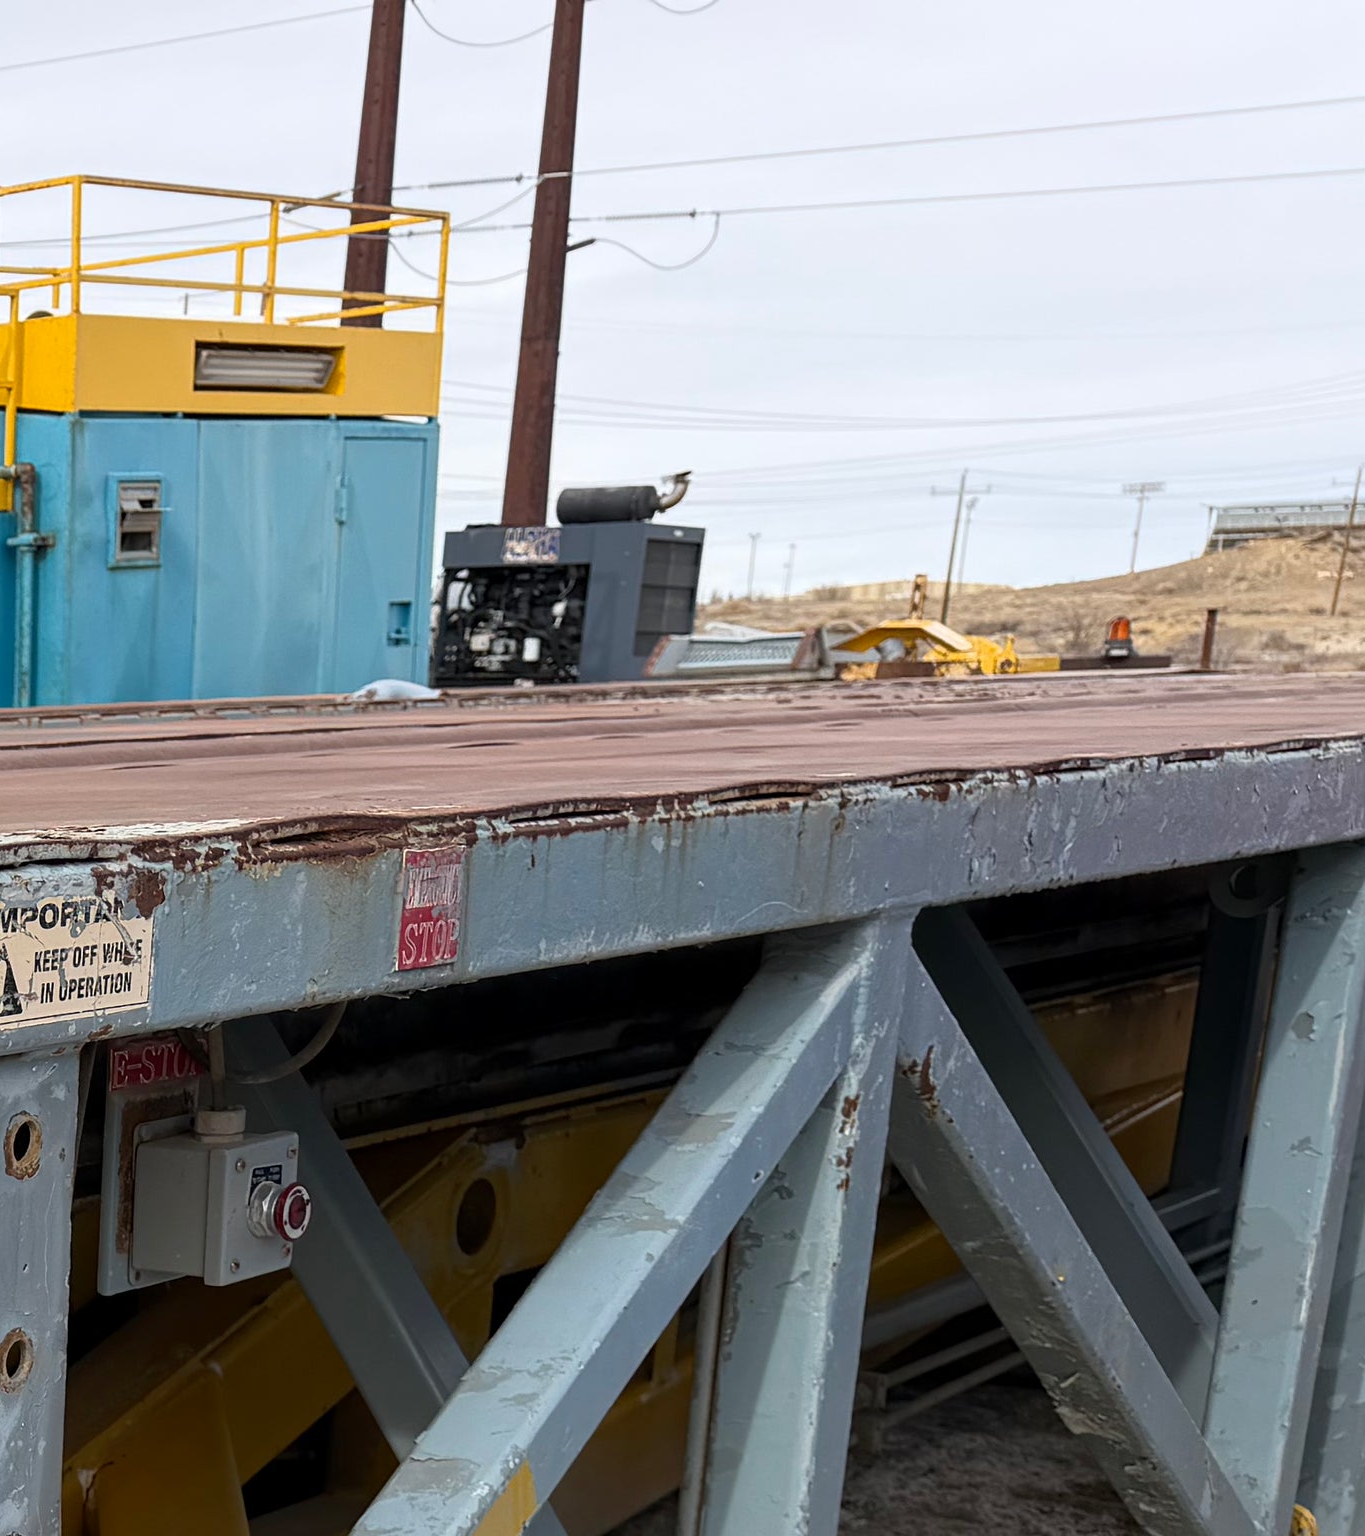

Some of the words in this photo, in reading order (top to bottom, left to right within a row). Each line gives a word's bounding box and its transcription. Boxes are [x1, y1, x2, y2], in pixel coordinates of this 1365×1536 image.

[34, 948, 68, 973] KEEP
[72, 944, 98, 968] OFF
[102, 939, 143, 964] WHE
[402, 918, 460, 965] STOP
[40, 982, 54, 1004] IN
[58, 971, 133, 1002] OPERATION
